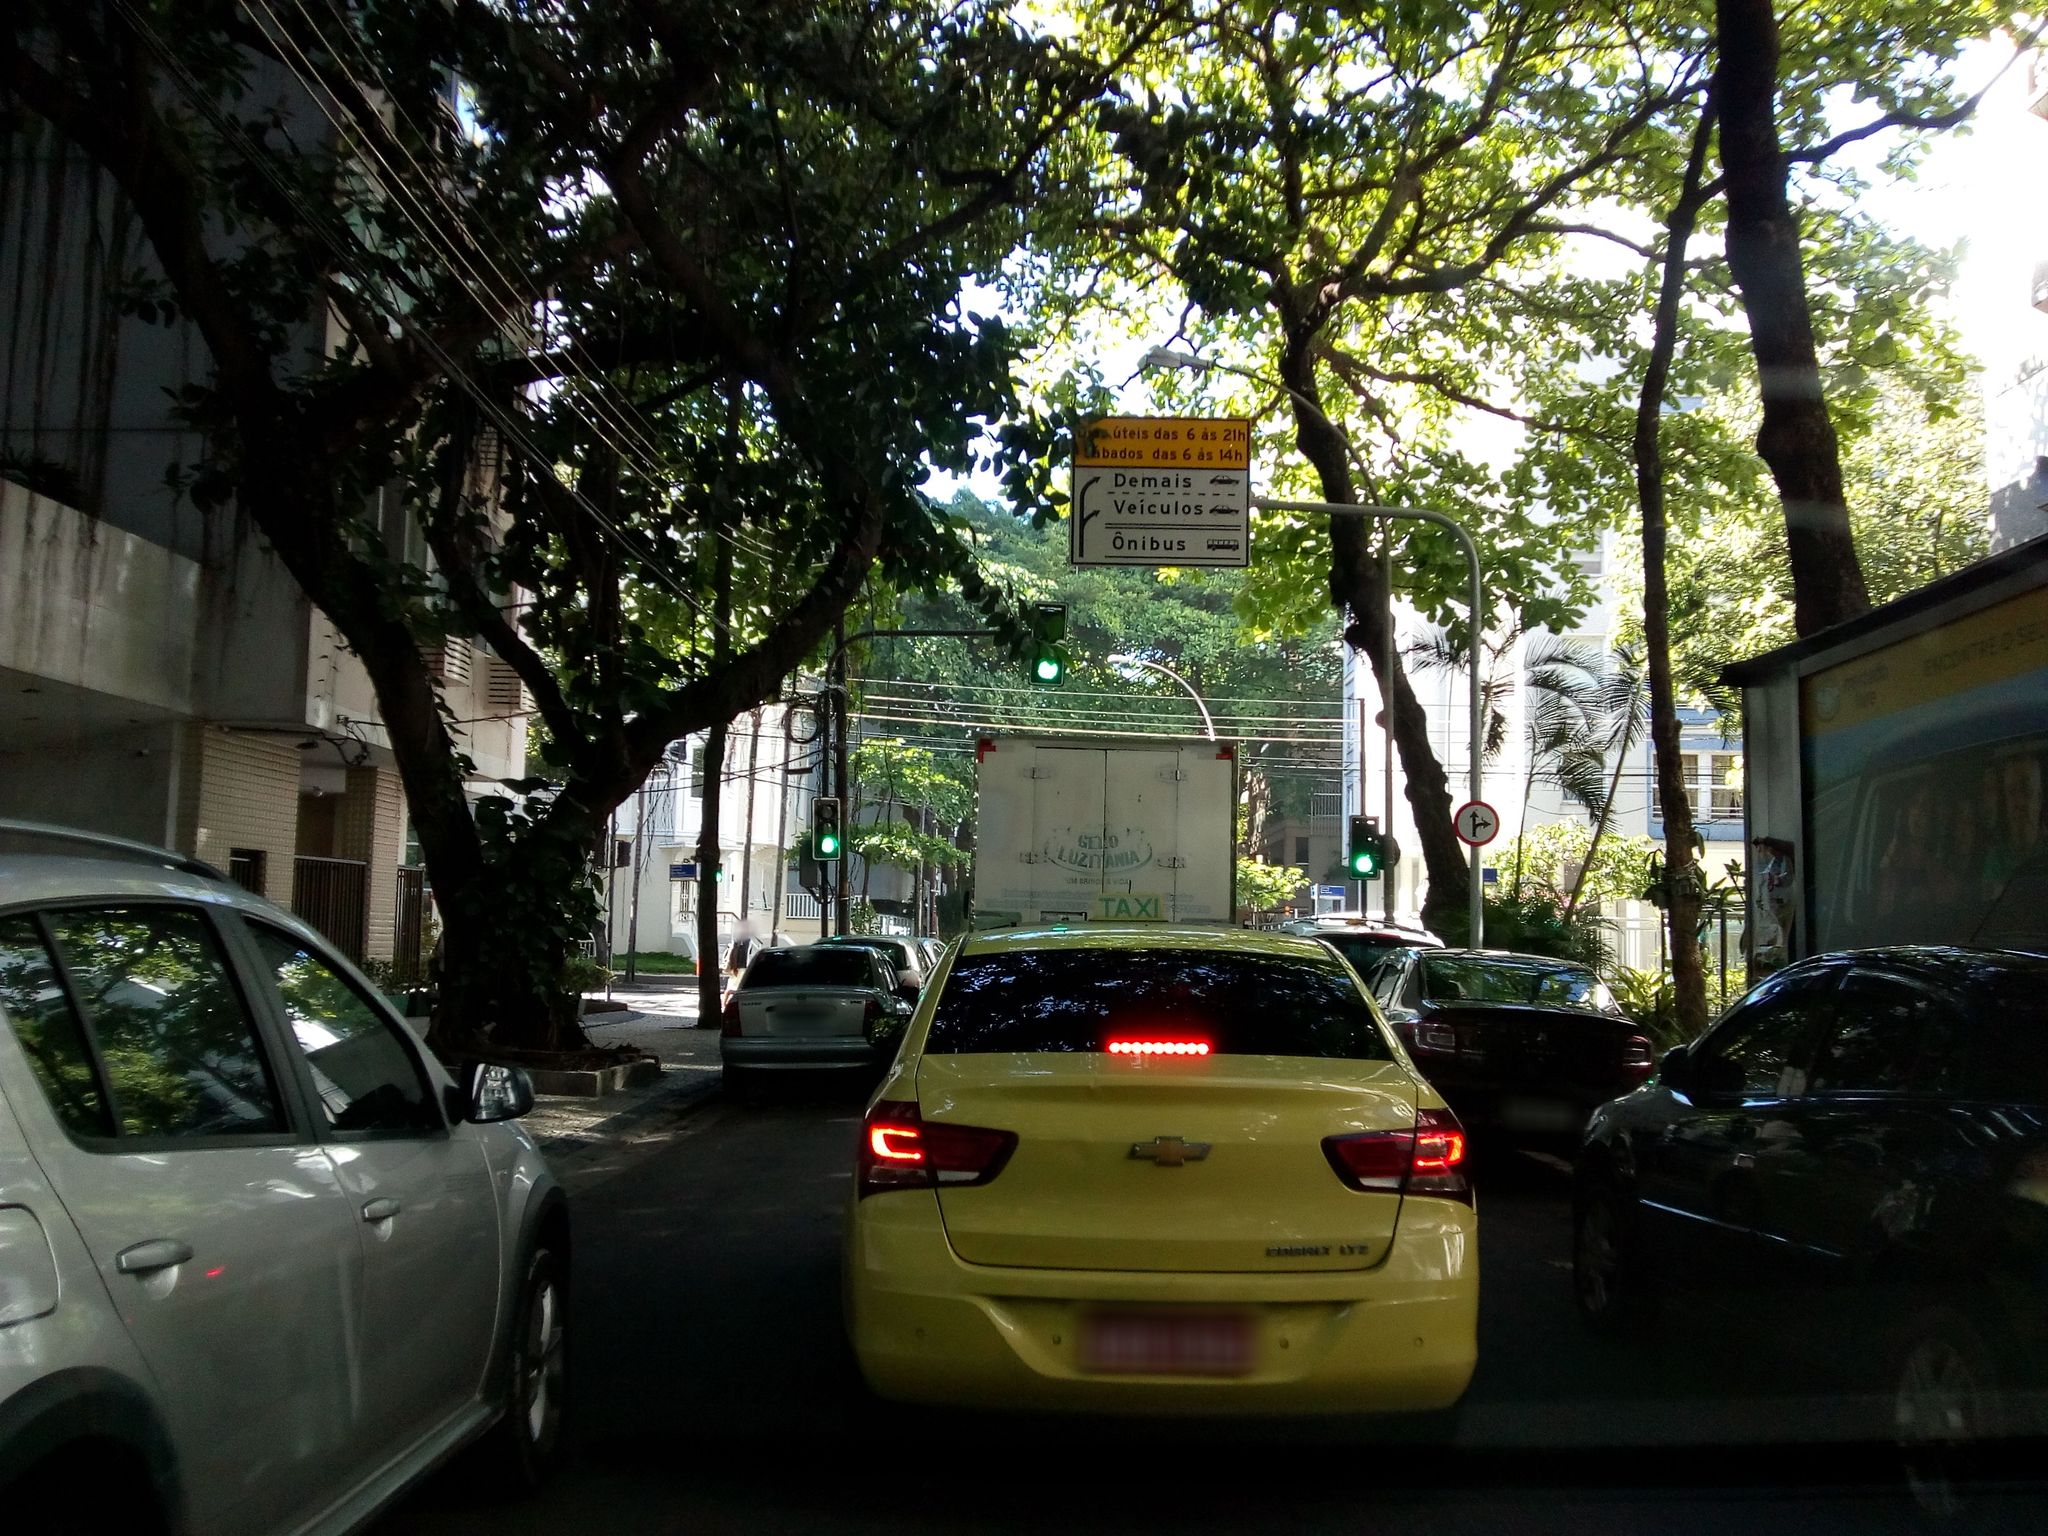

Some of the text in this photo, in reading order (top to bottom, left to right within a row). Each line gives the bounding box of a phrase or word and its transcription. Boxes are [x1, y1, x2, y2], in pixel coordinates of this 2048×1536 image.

[1113, 425, 1149, 441] úteis
[1153, 427, 1178, 441] das
[1187, 428, 1196, 441] 6
[1223, 429, 1246, 442] 21h
[1085, 446, 1143, 460] ábados
[1152, 448, 1177, 460] das
[1183, 448, 1192, 461] 6
[1219, 449, 1243, 462] 14h
[1114, 473, 1192, 488] Demais
[1114, 499, 1204, 515] Veículos
[1112, 531, 1186, 551] Ônibus
[1098, 897, 1162, 919] TAXI
